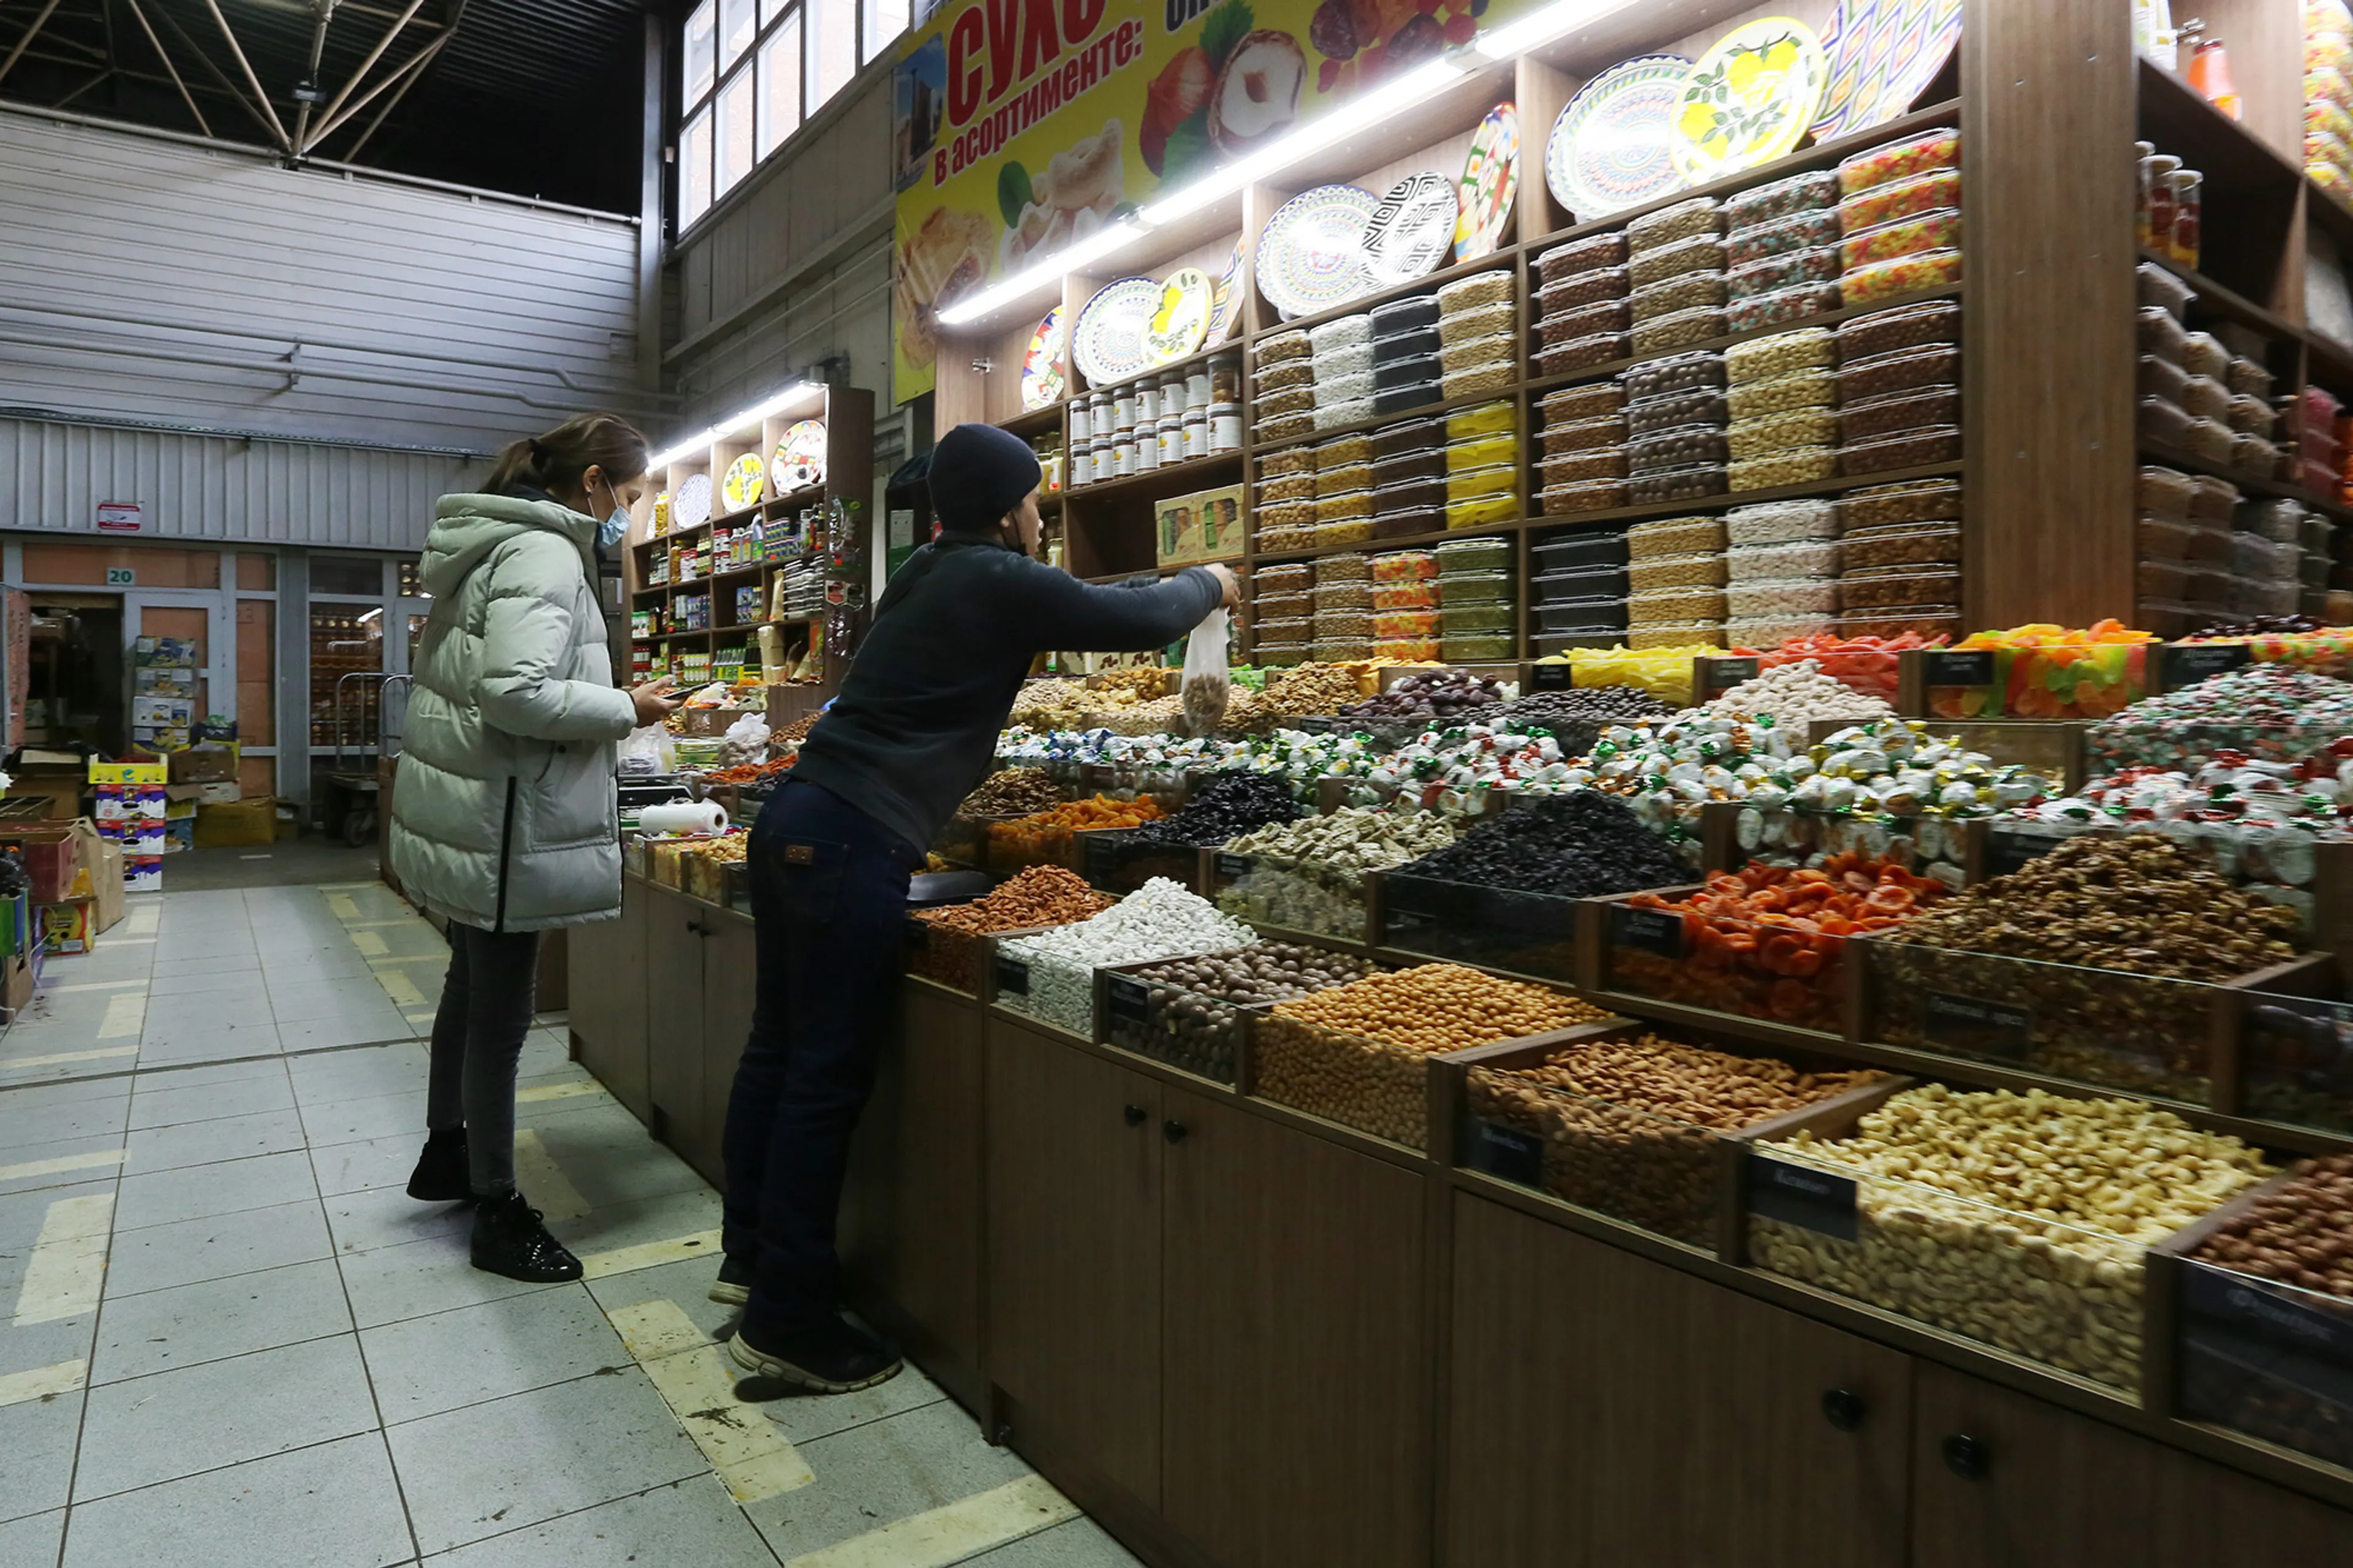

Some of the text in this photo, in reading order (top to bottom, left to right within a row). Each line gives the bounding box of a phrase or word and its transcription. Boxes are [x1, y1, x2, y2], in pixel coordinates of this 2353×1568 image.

[935, 20, 1142, 186] в асортименте:
[110, 570, 132, 583] 20
